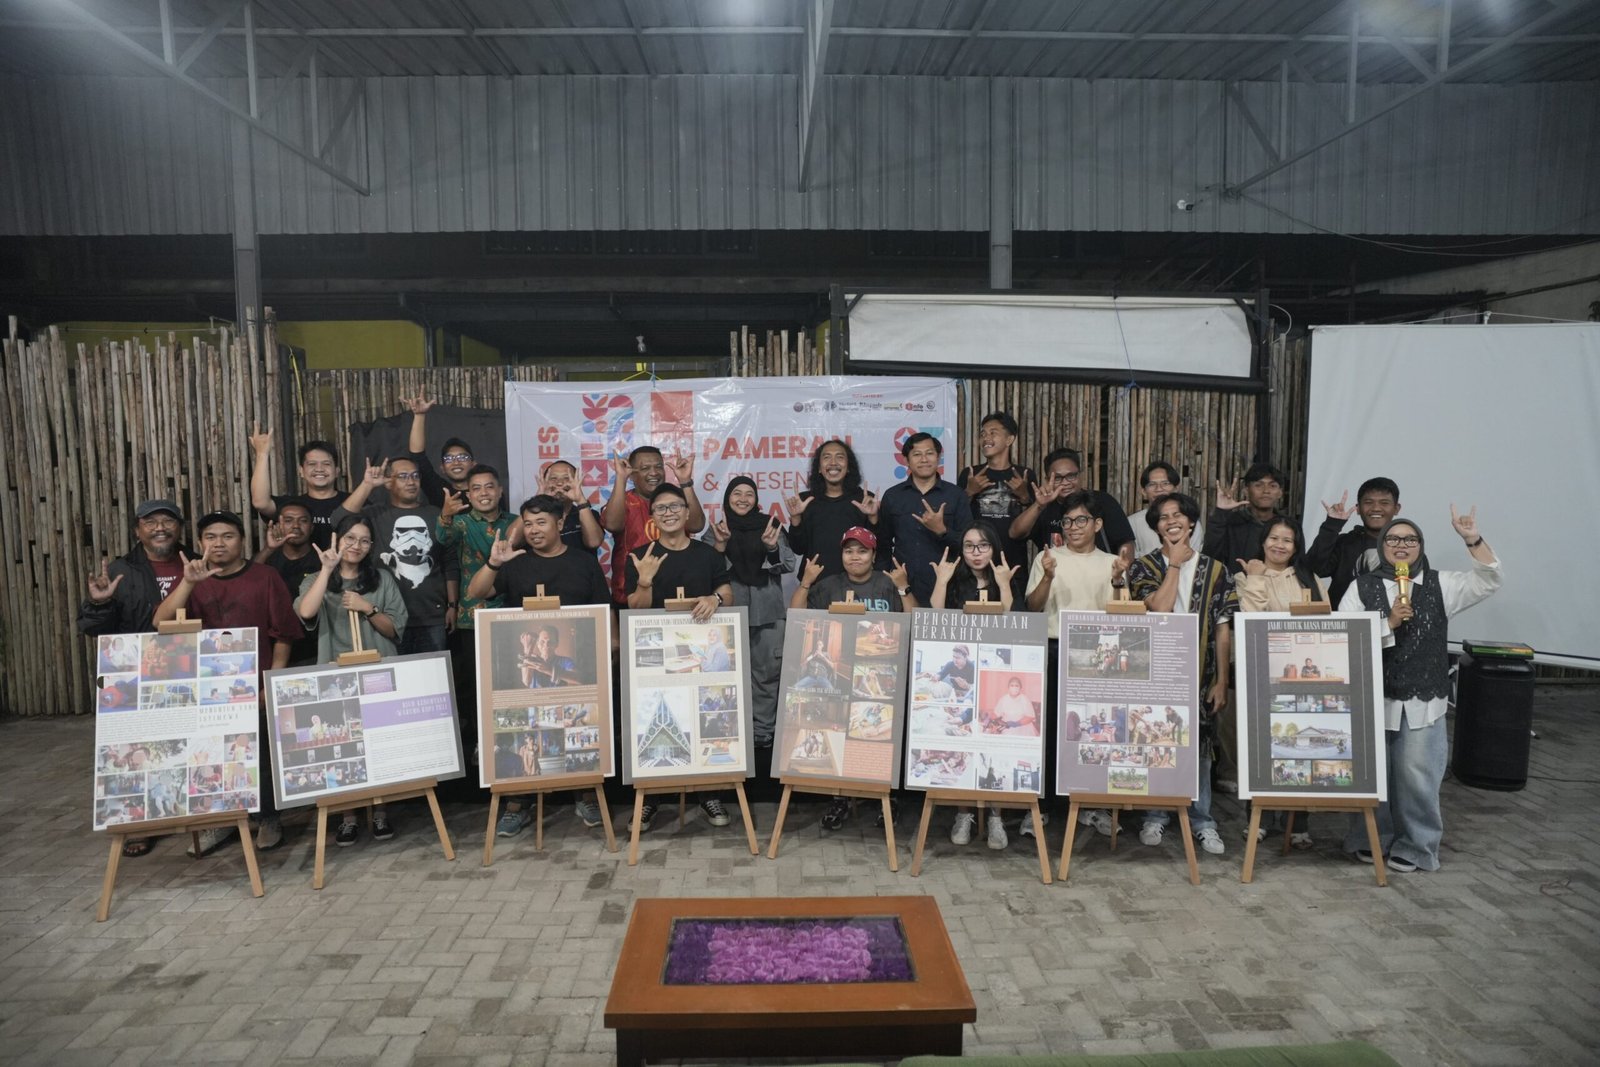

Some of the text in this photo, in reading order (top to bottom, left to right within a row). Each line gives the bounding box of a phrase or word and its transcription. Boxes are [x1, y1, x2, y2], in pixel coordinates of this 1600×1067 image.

[703, 473, 719, 491] &
[914, 611, 1028, 629] PENGHORMATAN
[914, 625, 983, 641] TERAKHIR
